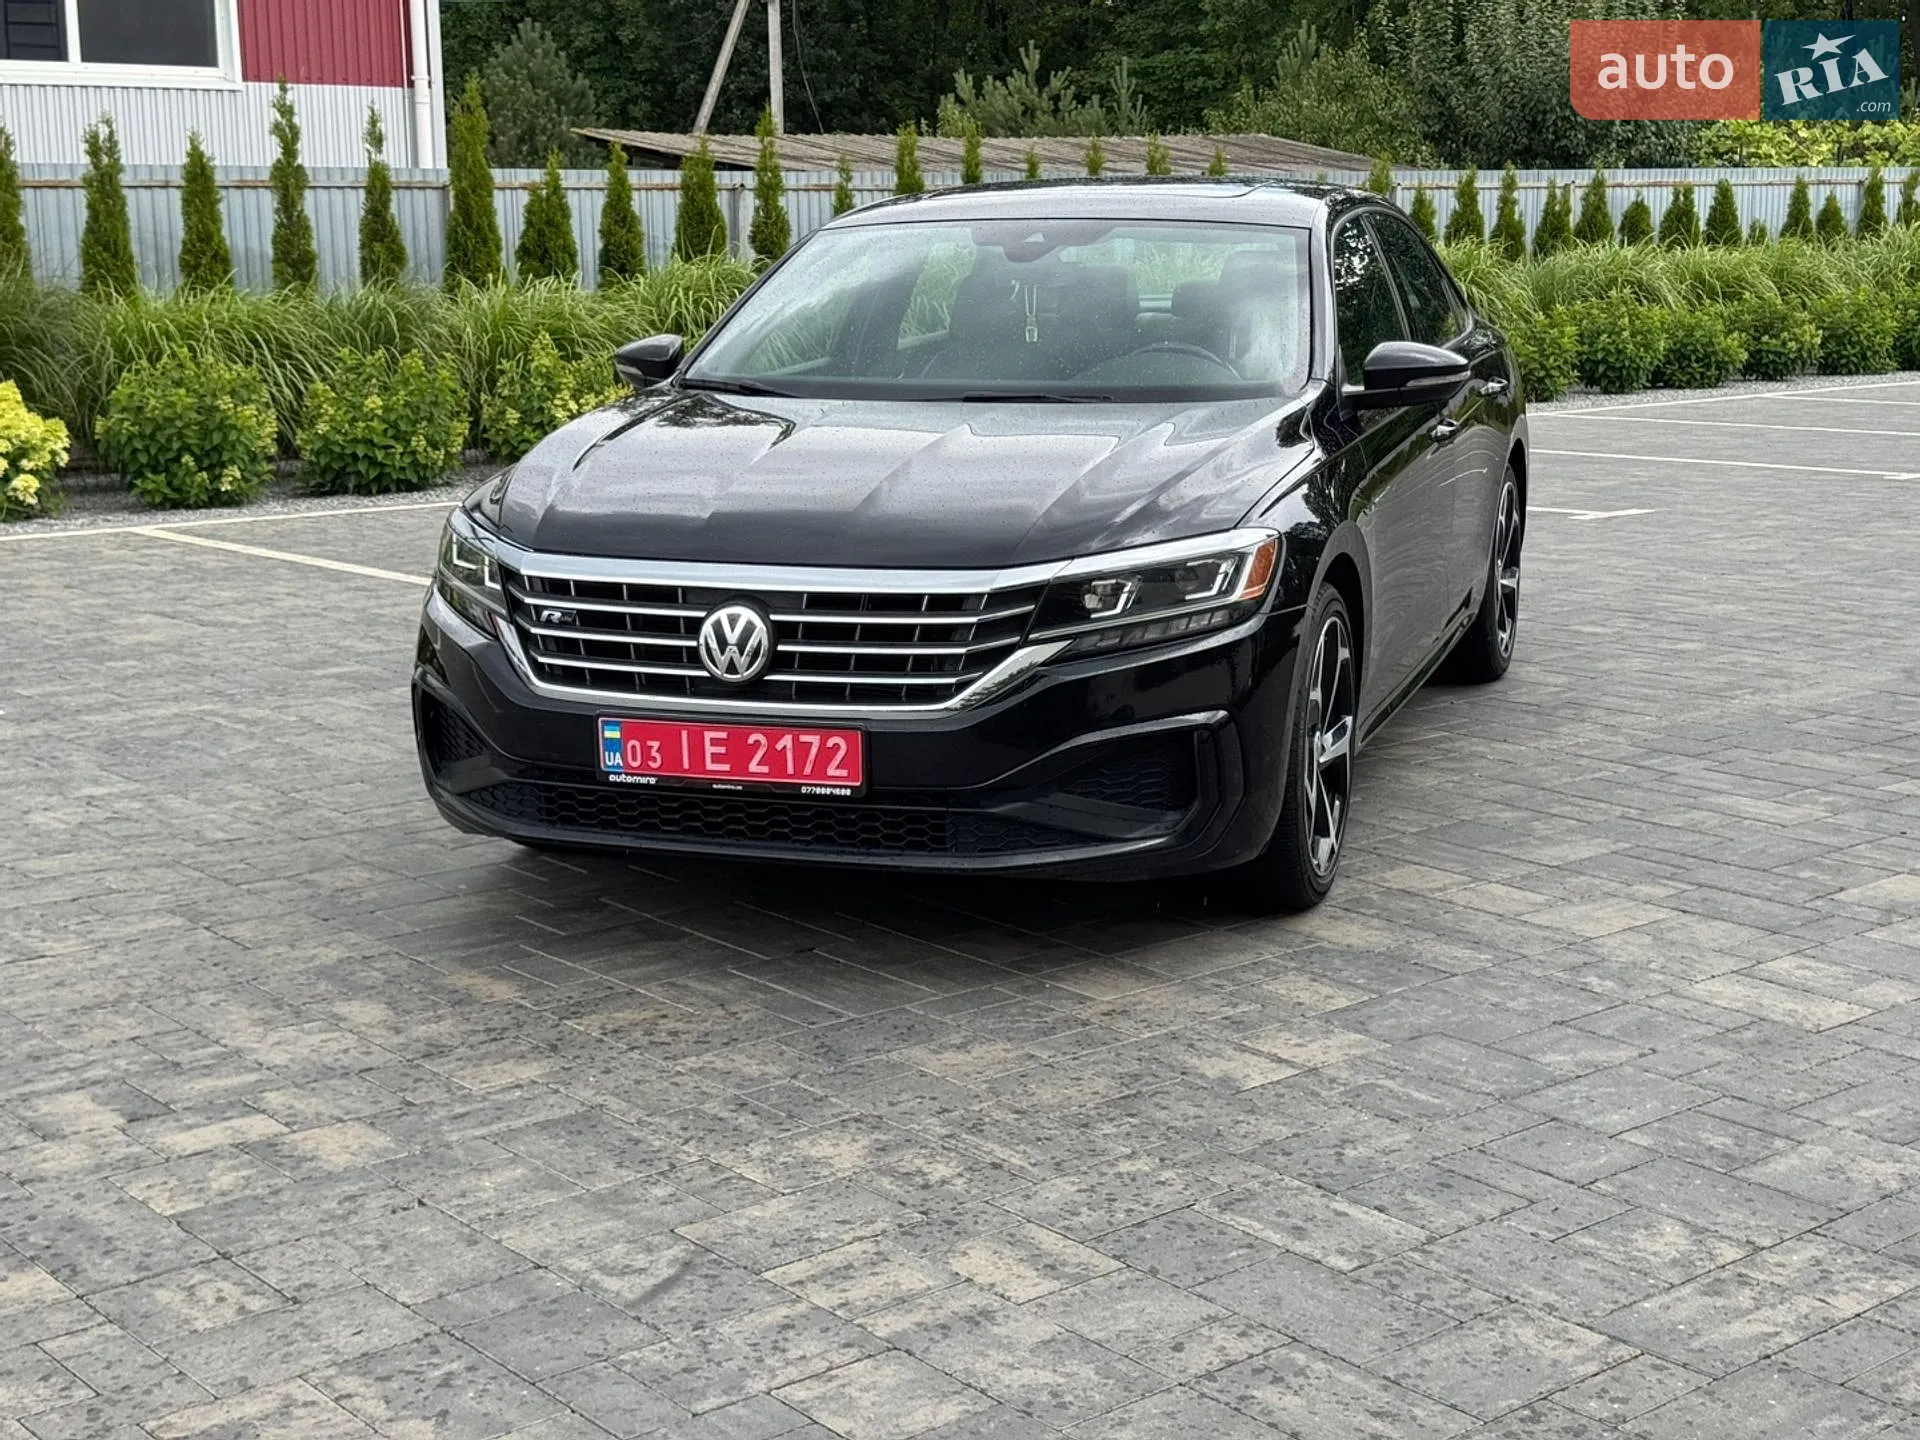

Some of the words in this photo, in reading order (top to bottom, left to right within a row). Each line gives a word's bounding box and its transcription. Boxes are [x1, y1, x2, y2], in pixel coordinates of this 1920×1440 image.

[605, 751, 623, 767] UA
[627, 739, 662, 769] 03
[680, 729, 731, 771] IE
[747, 733, 849, 777] 2172
